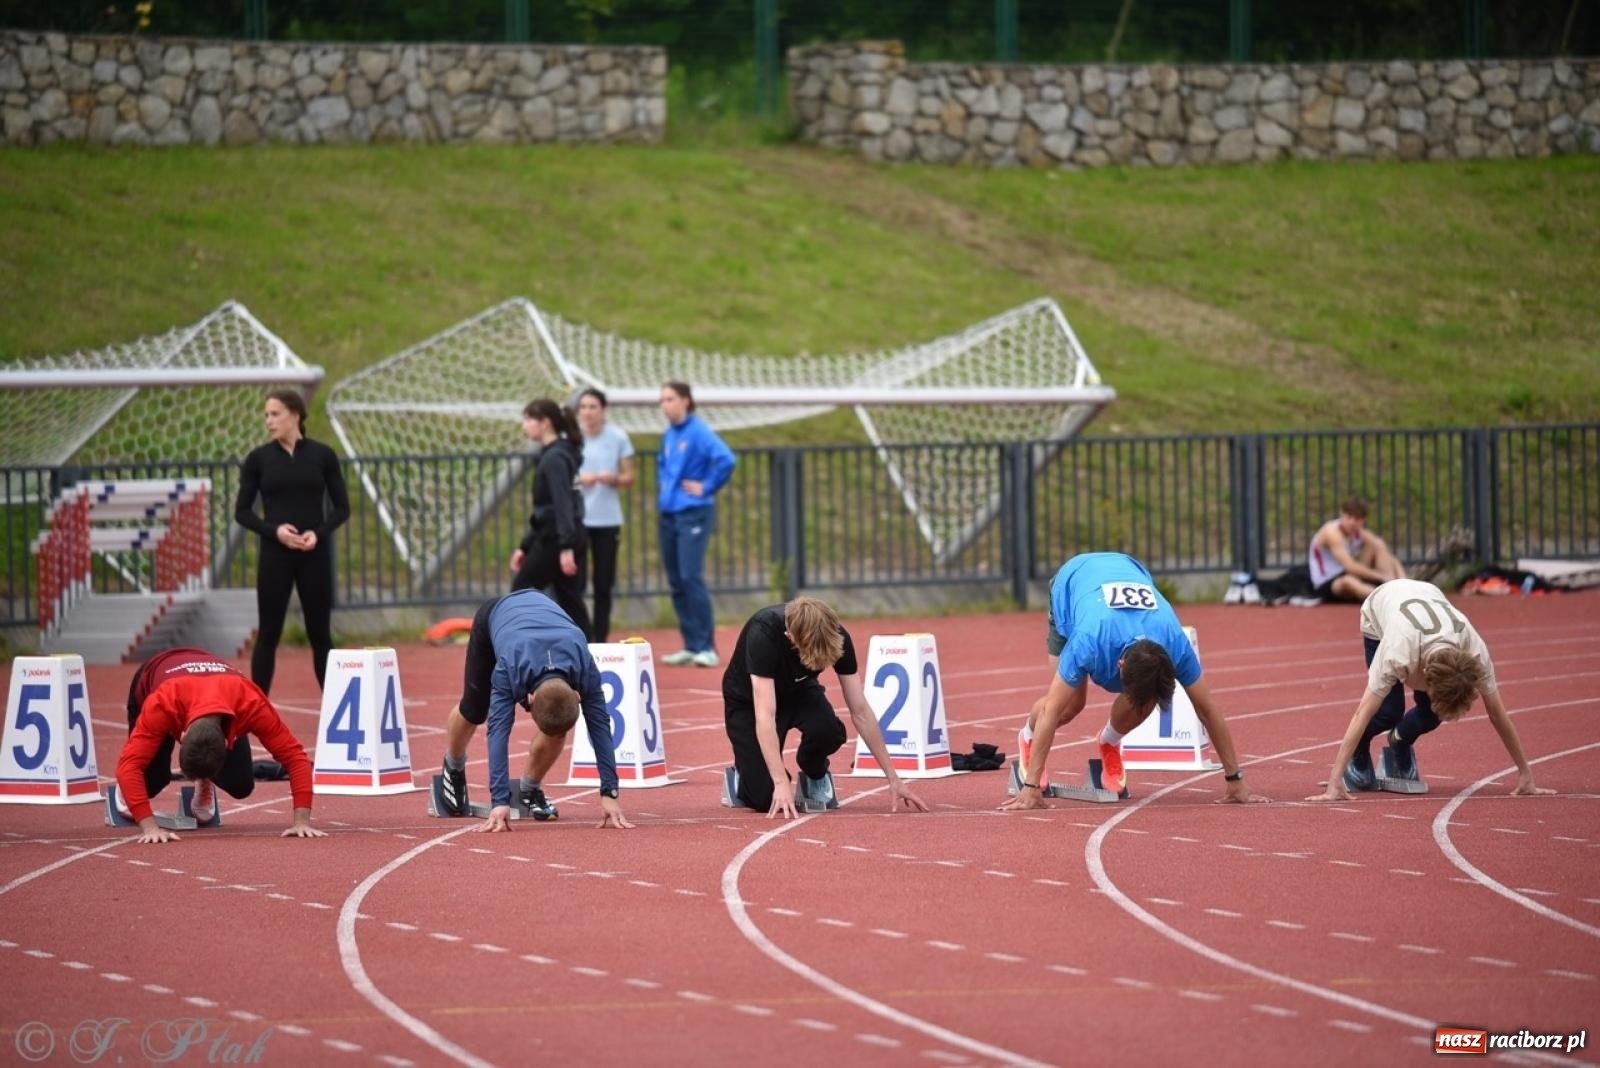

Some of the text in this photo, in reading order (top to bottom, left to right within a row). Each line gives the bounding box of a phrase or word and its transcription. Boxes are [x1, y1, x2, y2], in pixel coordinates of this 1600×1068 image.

[1110, 587, 1155, 608] 337
[12, 684, 51, 770] 5
[68, 683, 89, 769] 5
[326, 676, 365, 761] 4
[380, 674, 403, 759] 4
[640, 670, 657, 753] 3
[873, 662, 910, 745] 2
[923, 661, 943, 744] 2
[1174, 729, 1191, 740] Km
[43, 764, 58, 775] Km
[620, 750, 635, 761] Km
